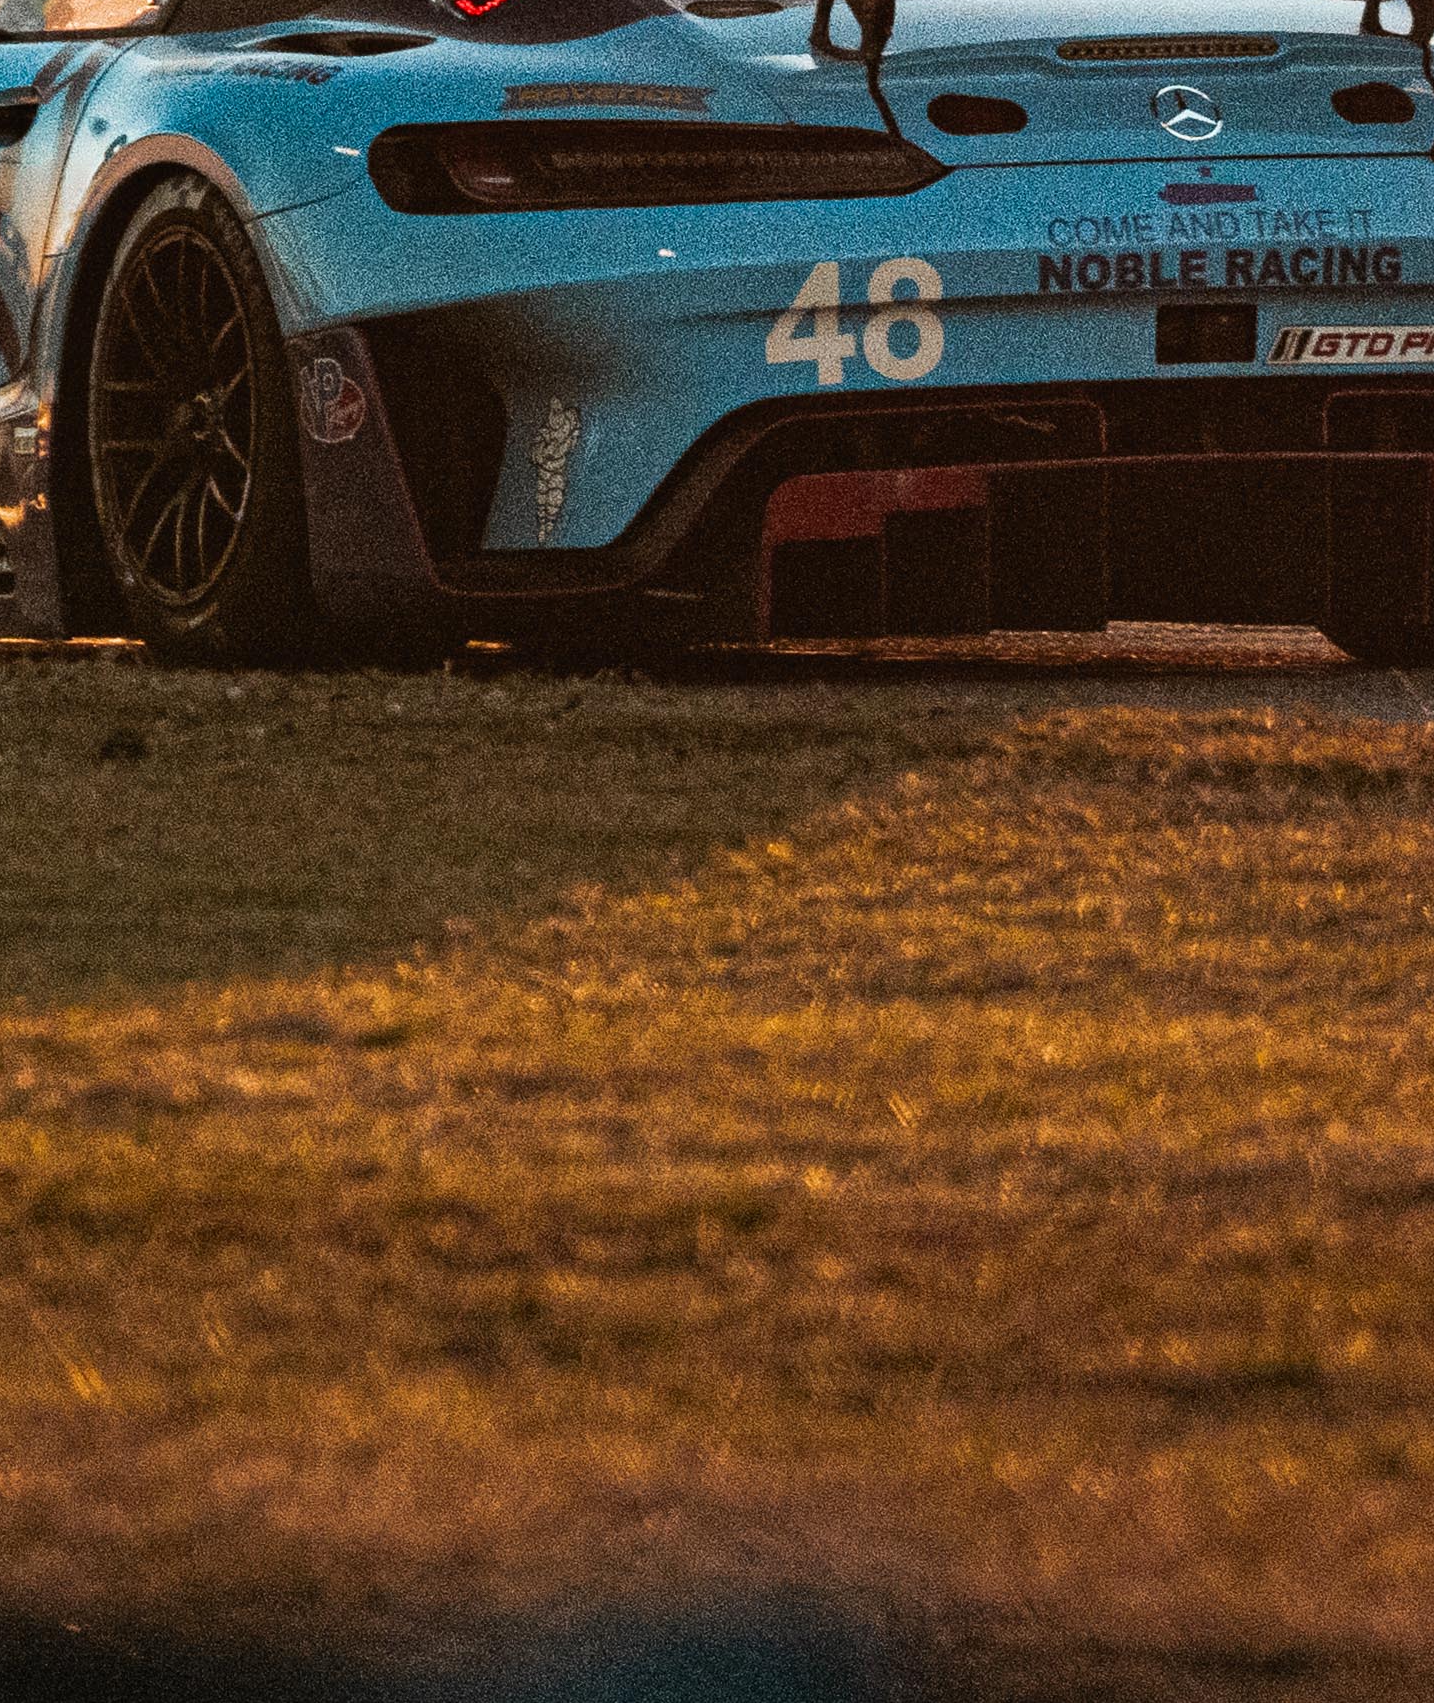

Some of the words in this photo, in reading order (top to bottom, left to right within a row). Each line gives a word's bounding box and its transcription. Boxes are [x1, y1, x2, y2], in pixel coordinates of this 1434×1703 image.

[1048, 213, 1151, 248] COME
[1166, 210, 1236, 242] AND
[1247, 207, 1330, 241] TAKE
[1336, 208, 1376, 239] IT
[1037, 249, 1209, 292] NOBLE
[1226, 245, 1403, 287] RACING
[765, 257, 945, 385] 48
[1312, 331, 1393, 358] GTD
